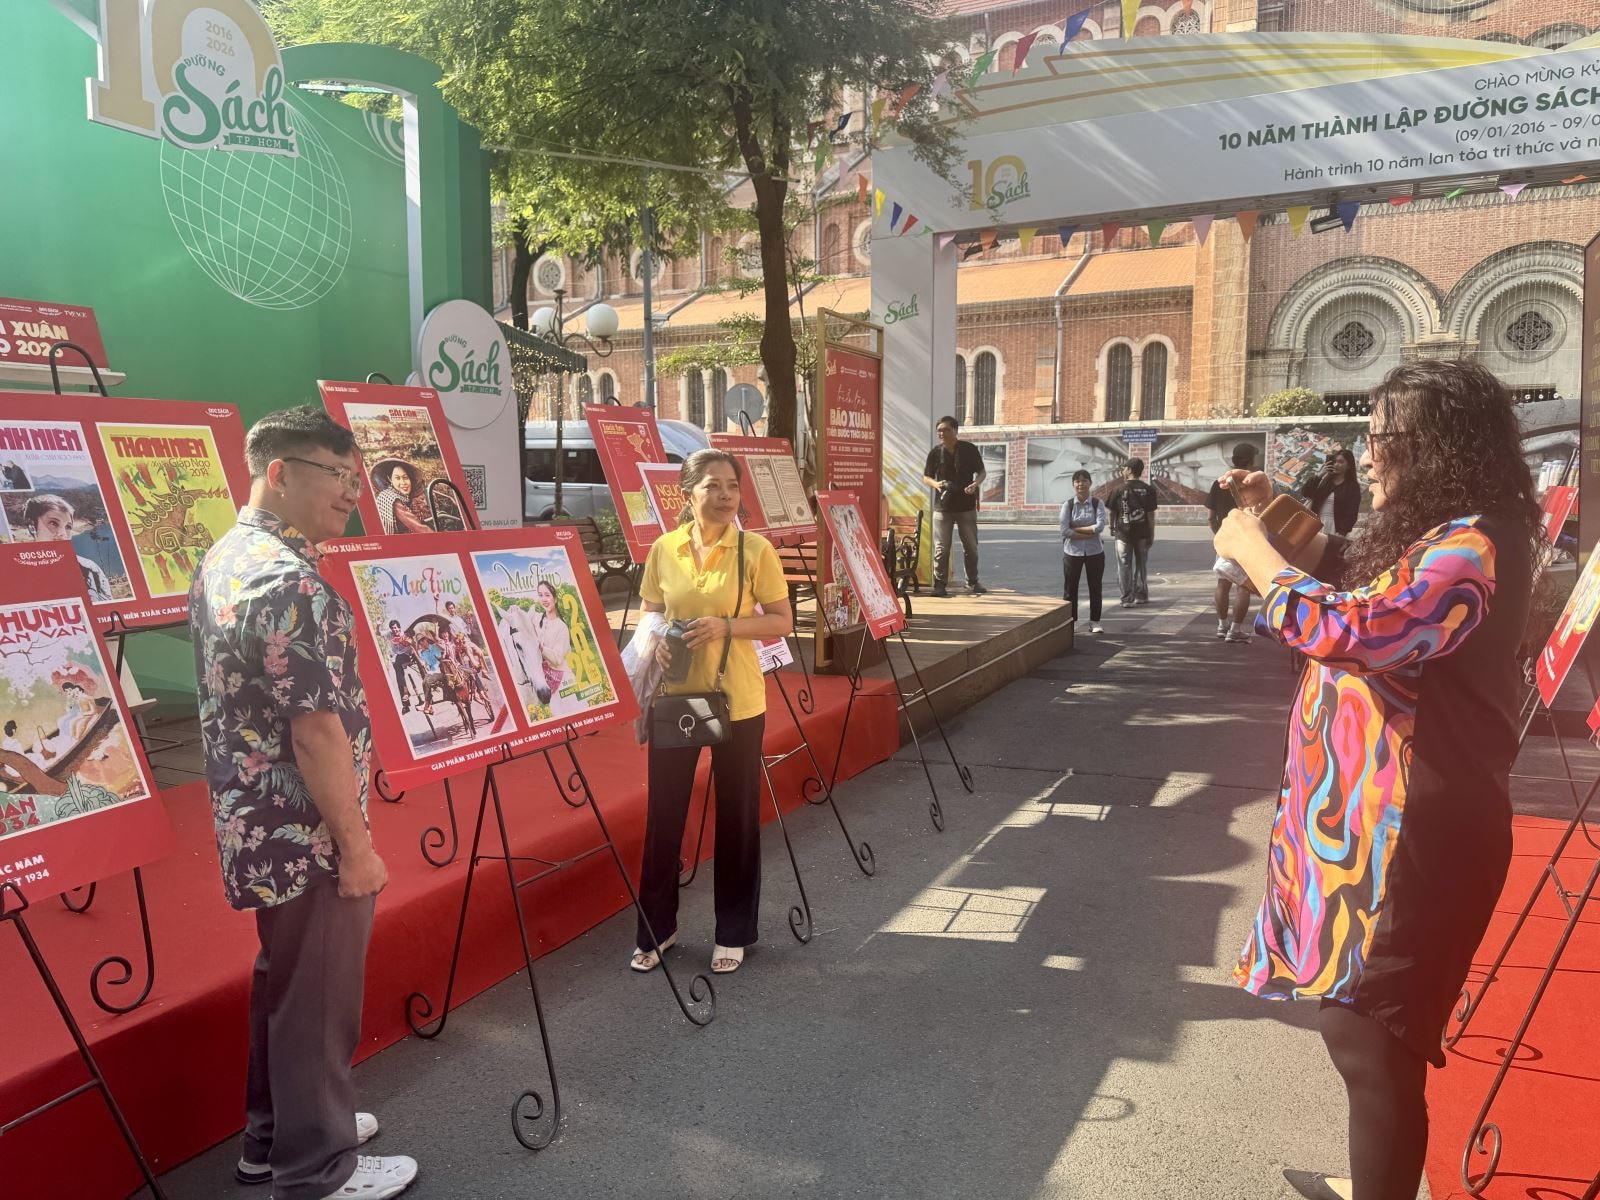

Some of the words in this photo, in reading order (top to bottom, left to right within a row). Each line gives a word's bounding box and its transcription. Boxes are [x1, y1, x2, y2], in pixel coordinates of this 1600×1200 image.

[205, 20, 233, 40] 2016
[206, 36, 235, 57] 2026
[1474, 73, 1520, 91] CHÀO
[1526, 66, 1575, 84] MỪNG
[163, 67, 294, 144] Sách
[1218, 132, 1242, 150] 10
[1247, 124, 1296, 147] NĂM
[1302, 116, 1378, 140] THÀNH
[1384, 107, 1428, 133] LẬP
[1434, 96, 1529, 123] ĐƯỜNG
[1456, 121, 1545, 143] (09/01/2016
[258, 138, 282, 148] HCM
[1284, 166, 1323, 181] Hành
[1328, 161, 1362, 176] trình
[1367, 158, 1384, 171] 10
[1389, 156, 1424, 170] năm
[1429, 152, 1454, 165] lan
[1459, 148, 1488, 161] tỏa
[1493, 144, 1511, 158] tri
[1516, 140, 1555, 156] thức
[1560, 136, 1582, 151] và
[986, 171, 1031, 210] Sách
[884, 294, 918, 324] Sách
[9, 320, 70, 340] XUÂN
[429, 339, 502, 393] Sách
[829, 406, 848, 428] BÁO
[848, 409, 872, 430] XUÂN
[162, 605, 181, 615] CANH
[25, 868, 50, 884] 1934
